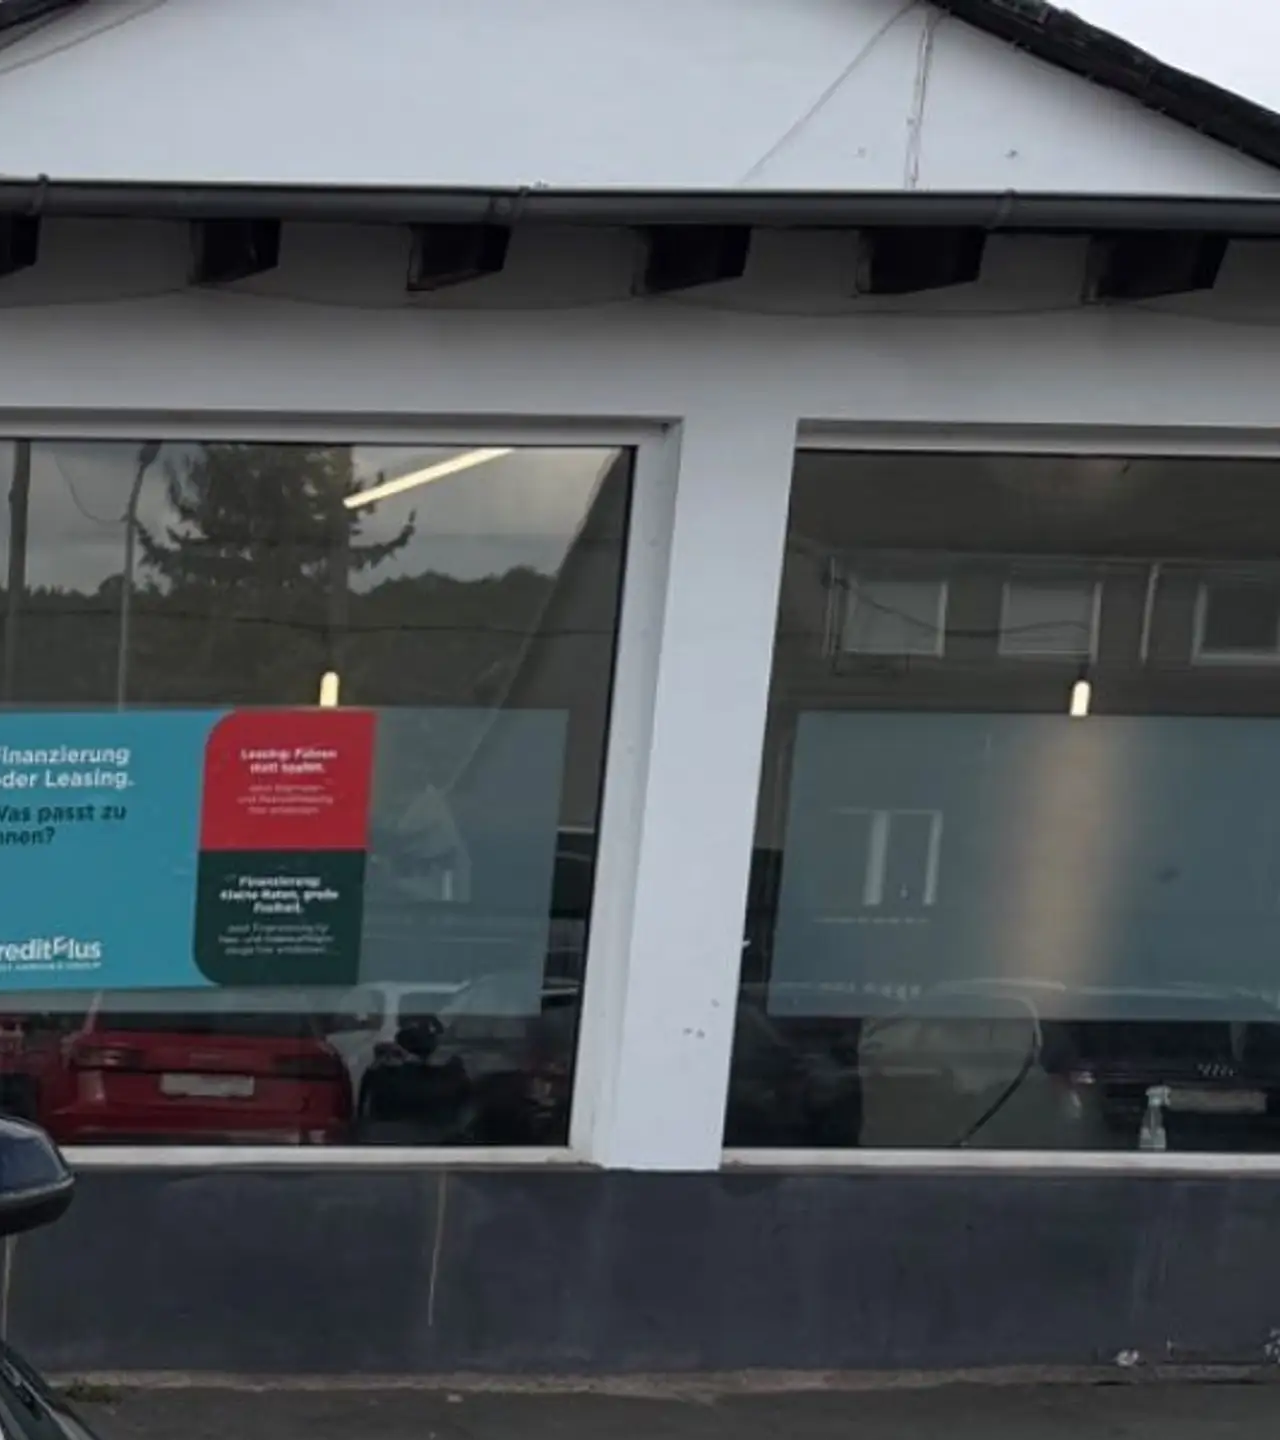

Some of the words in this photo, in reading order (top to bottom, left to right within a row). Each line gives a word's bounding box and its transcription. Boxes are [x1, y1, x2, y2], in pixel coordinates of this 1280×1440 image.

[45, 768, 135, 789] Leasing.
[38, 804, 95, 824] passt
[100, 805, 127, 821] zu
